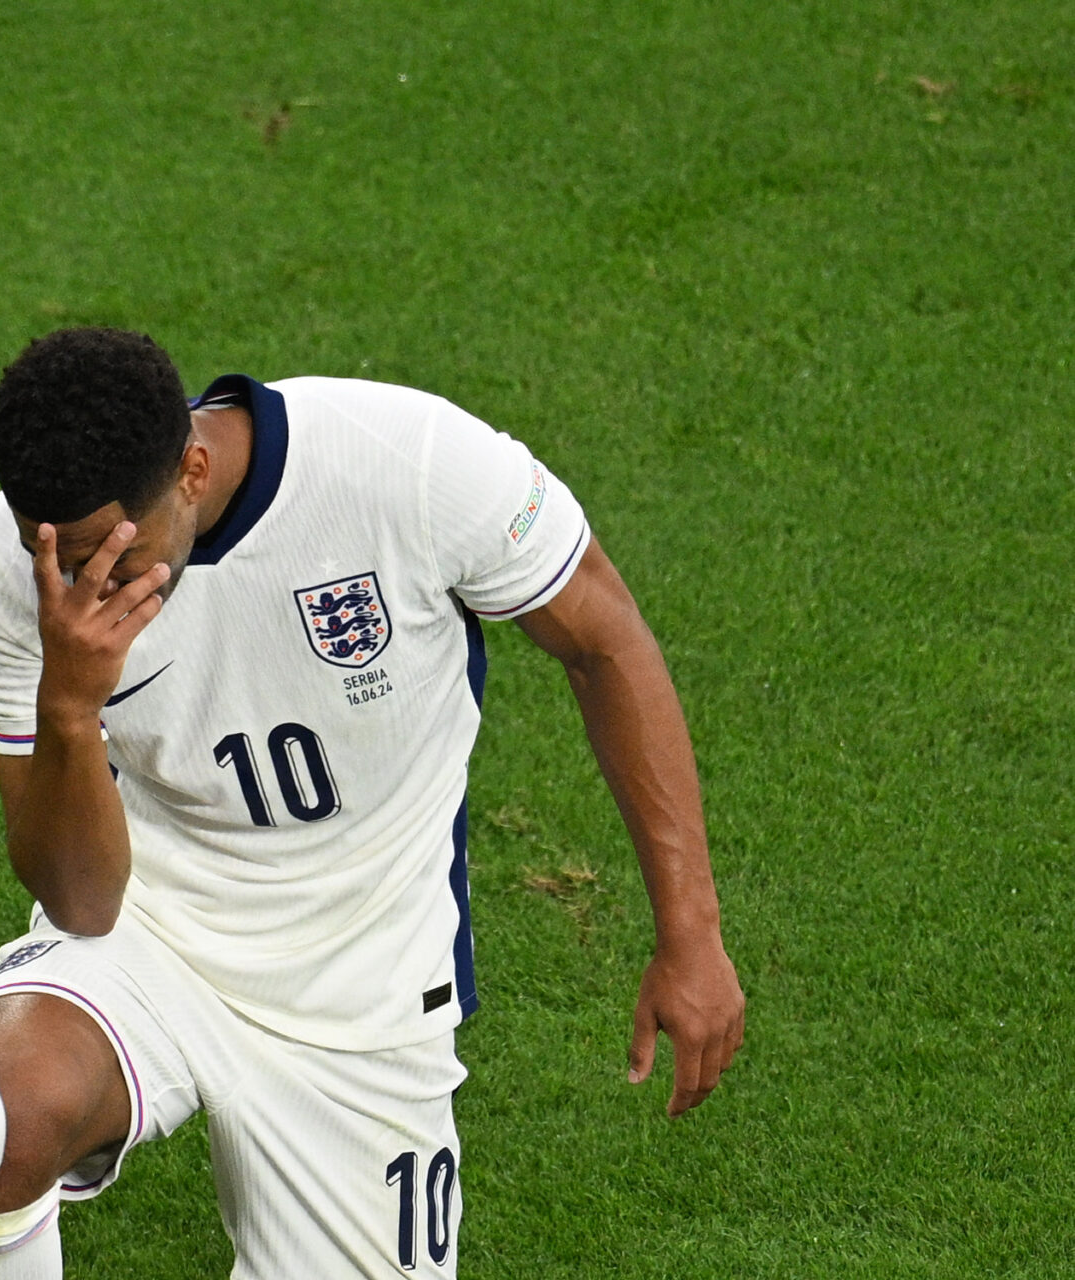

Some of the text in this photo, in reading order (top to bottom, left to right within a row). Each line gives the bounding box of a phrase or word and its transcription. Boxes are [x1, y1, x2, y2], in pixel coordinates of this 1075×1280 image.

[343, 668, 388, 690] SERBIA
[346, 681, 393, 706] 16.06.24
[213, 722, 342, 828] 10
[386, 1147, 457, 1271] 10
